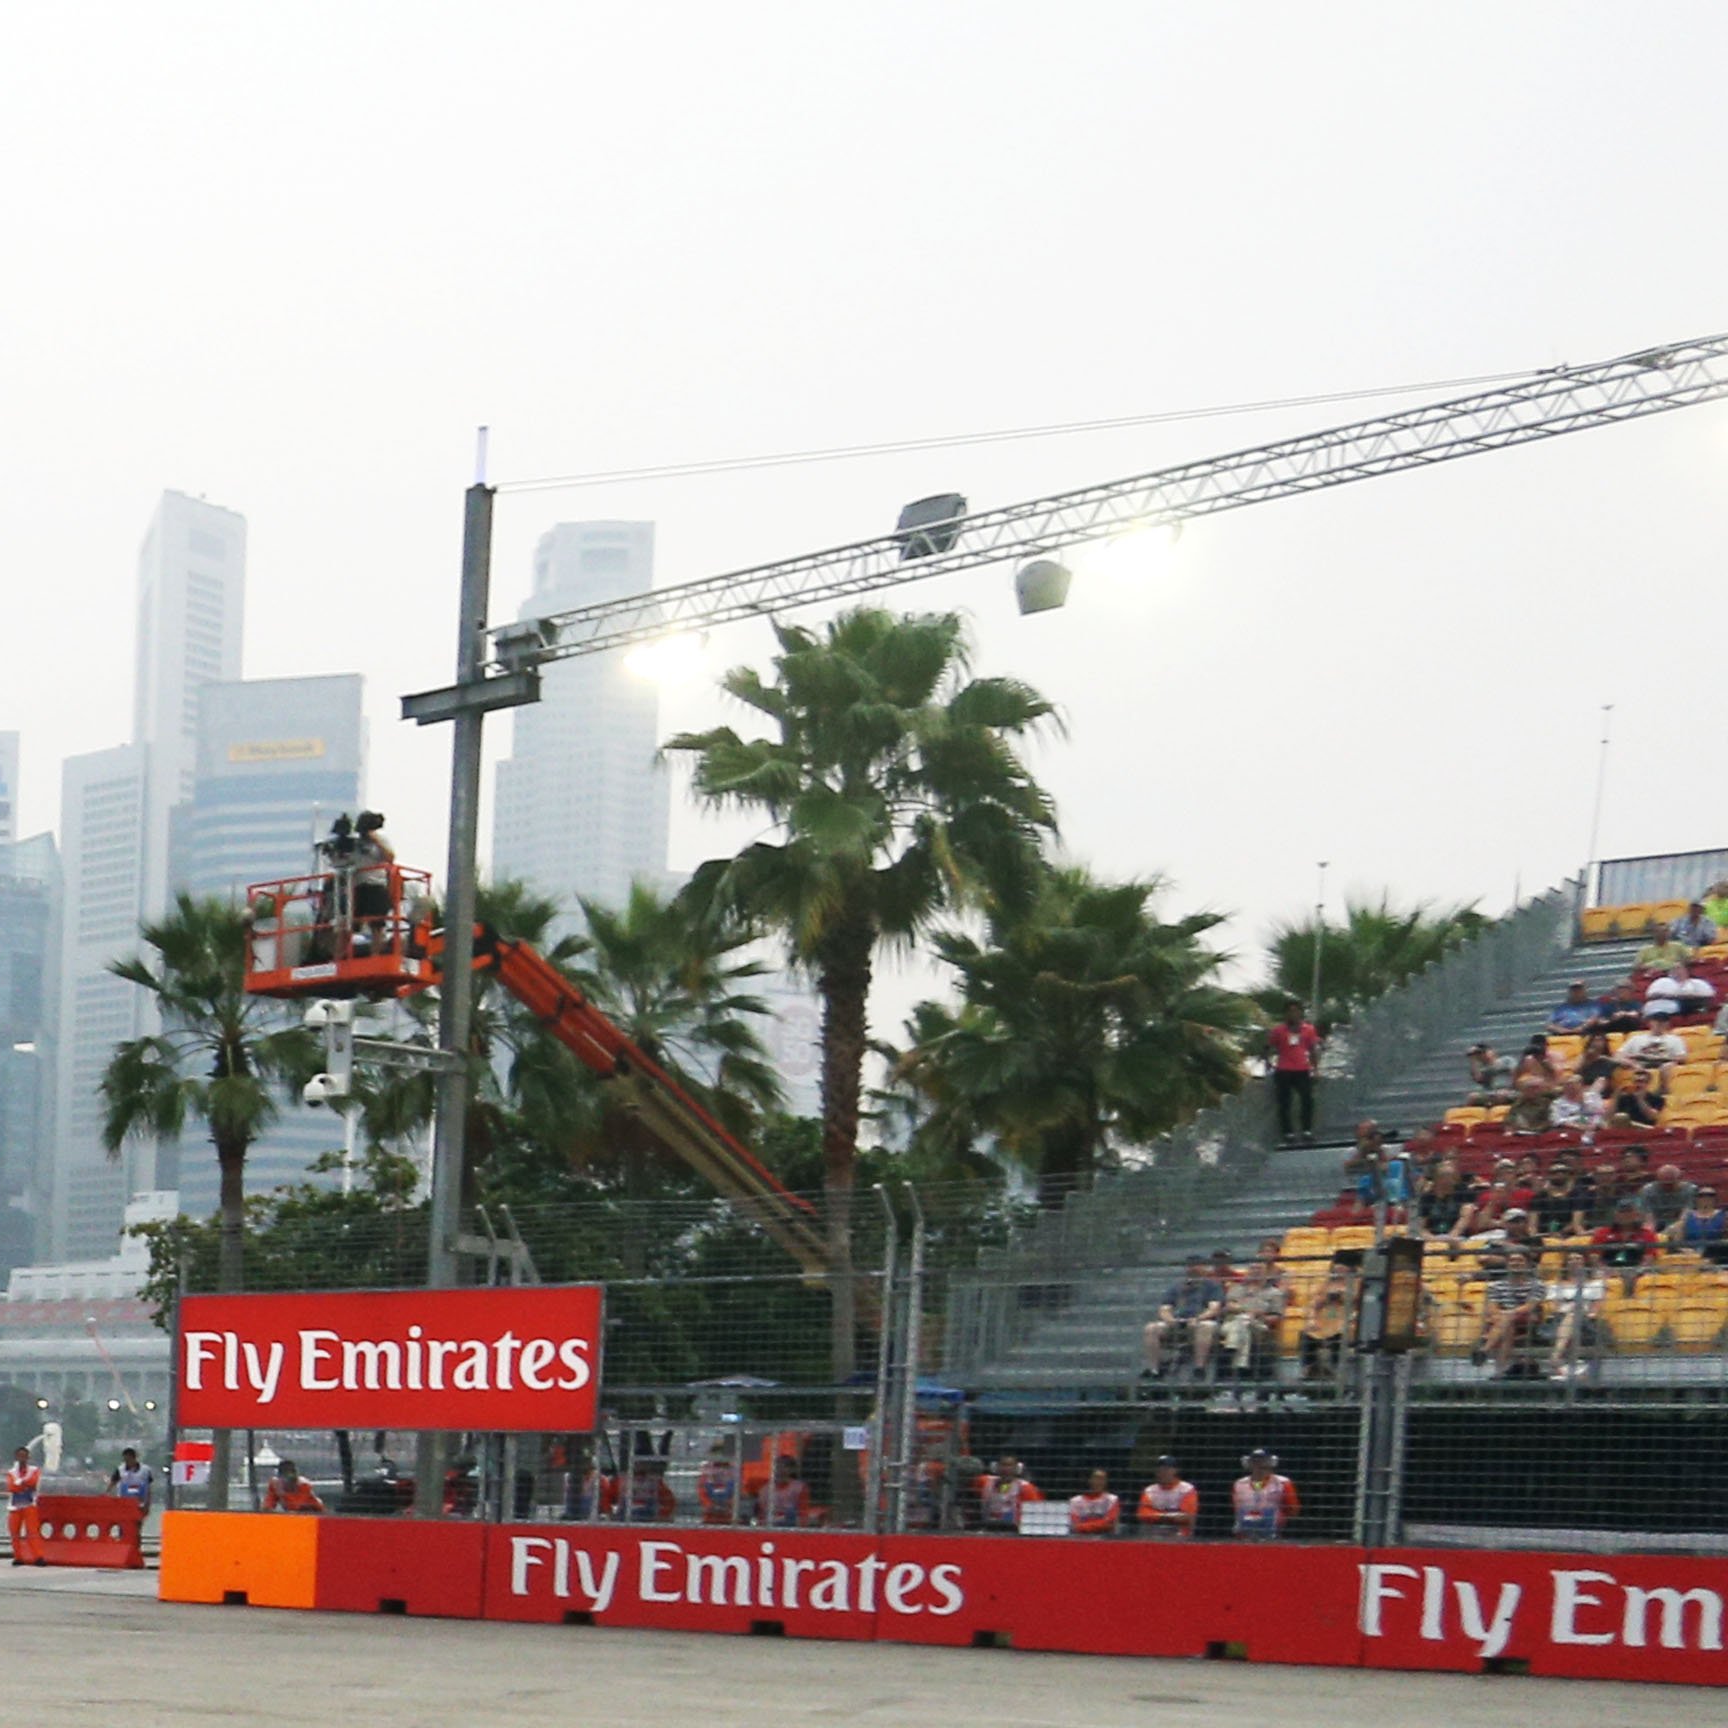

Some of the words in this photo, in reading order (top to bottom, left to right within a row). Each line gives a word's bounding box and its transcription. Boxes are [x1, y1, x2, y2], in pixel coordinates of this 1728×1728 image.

[185, 1332, 283, 1403] Fly
[299, 1326, 589, 1389] Emirates
[512, 1537, 619, 1611] Fly
[639, 1541, 963, 1614] Emirates
[1358, 1564, 1521, 1657] Fly
[1551, 1570, 1723, 1649] Em
